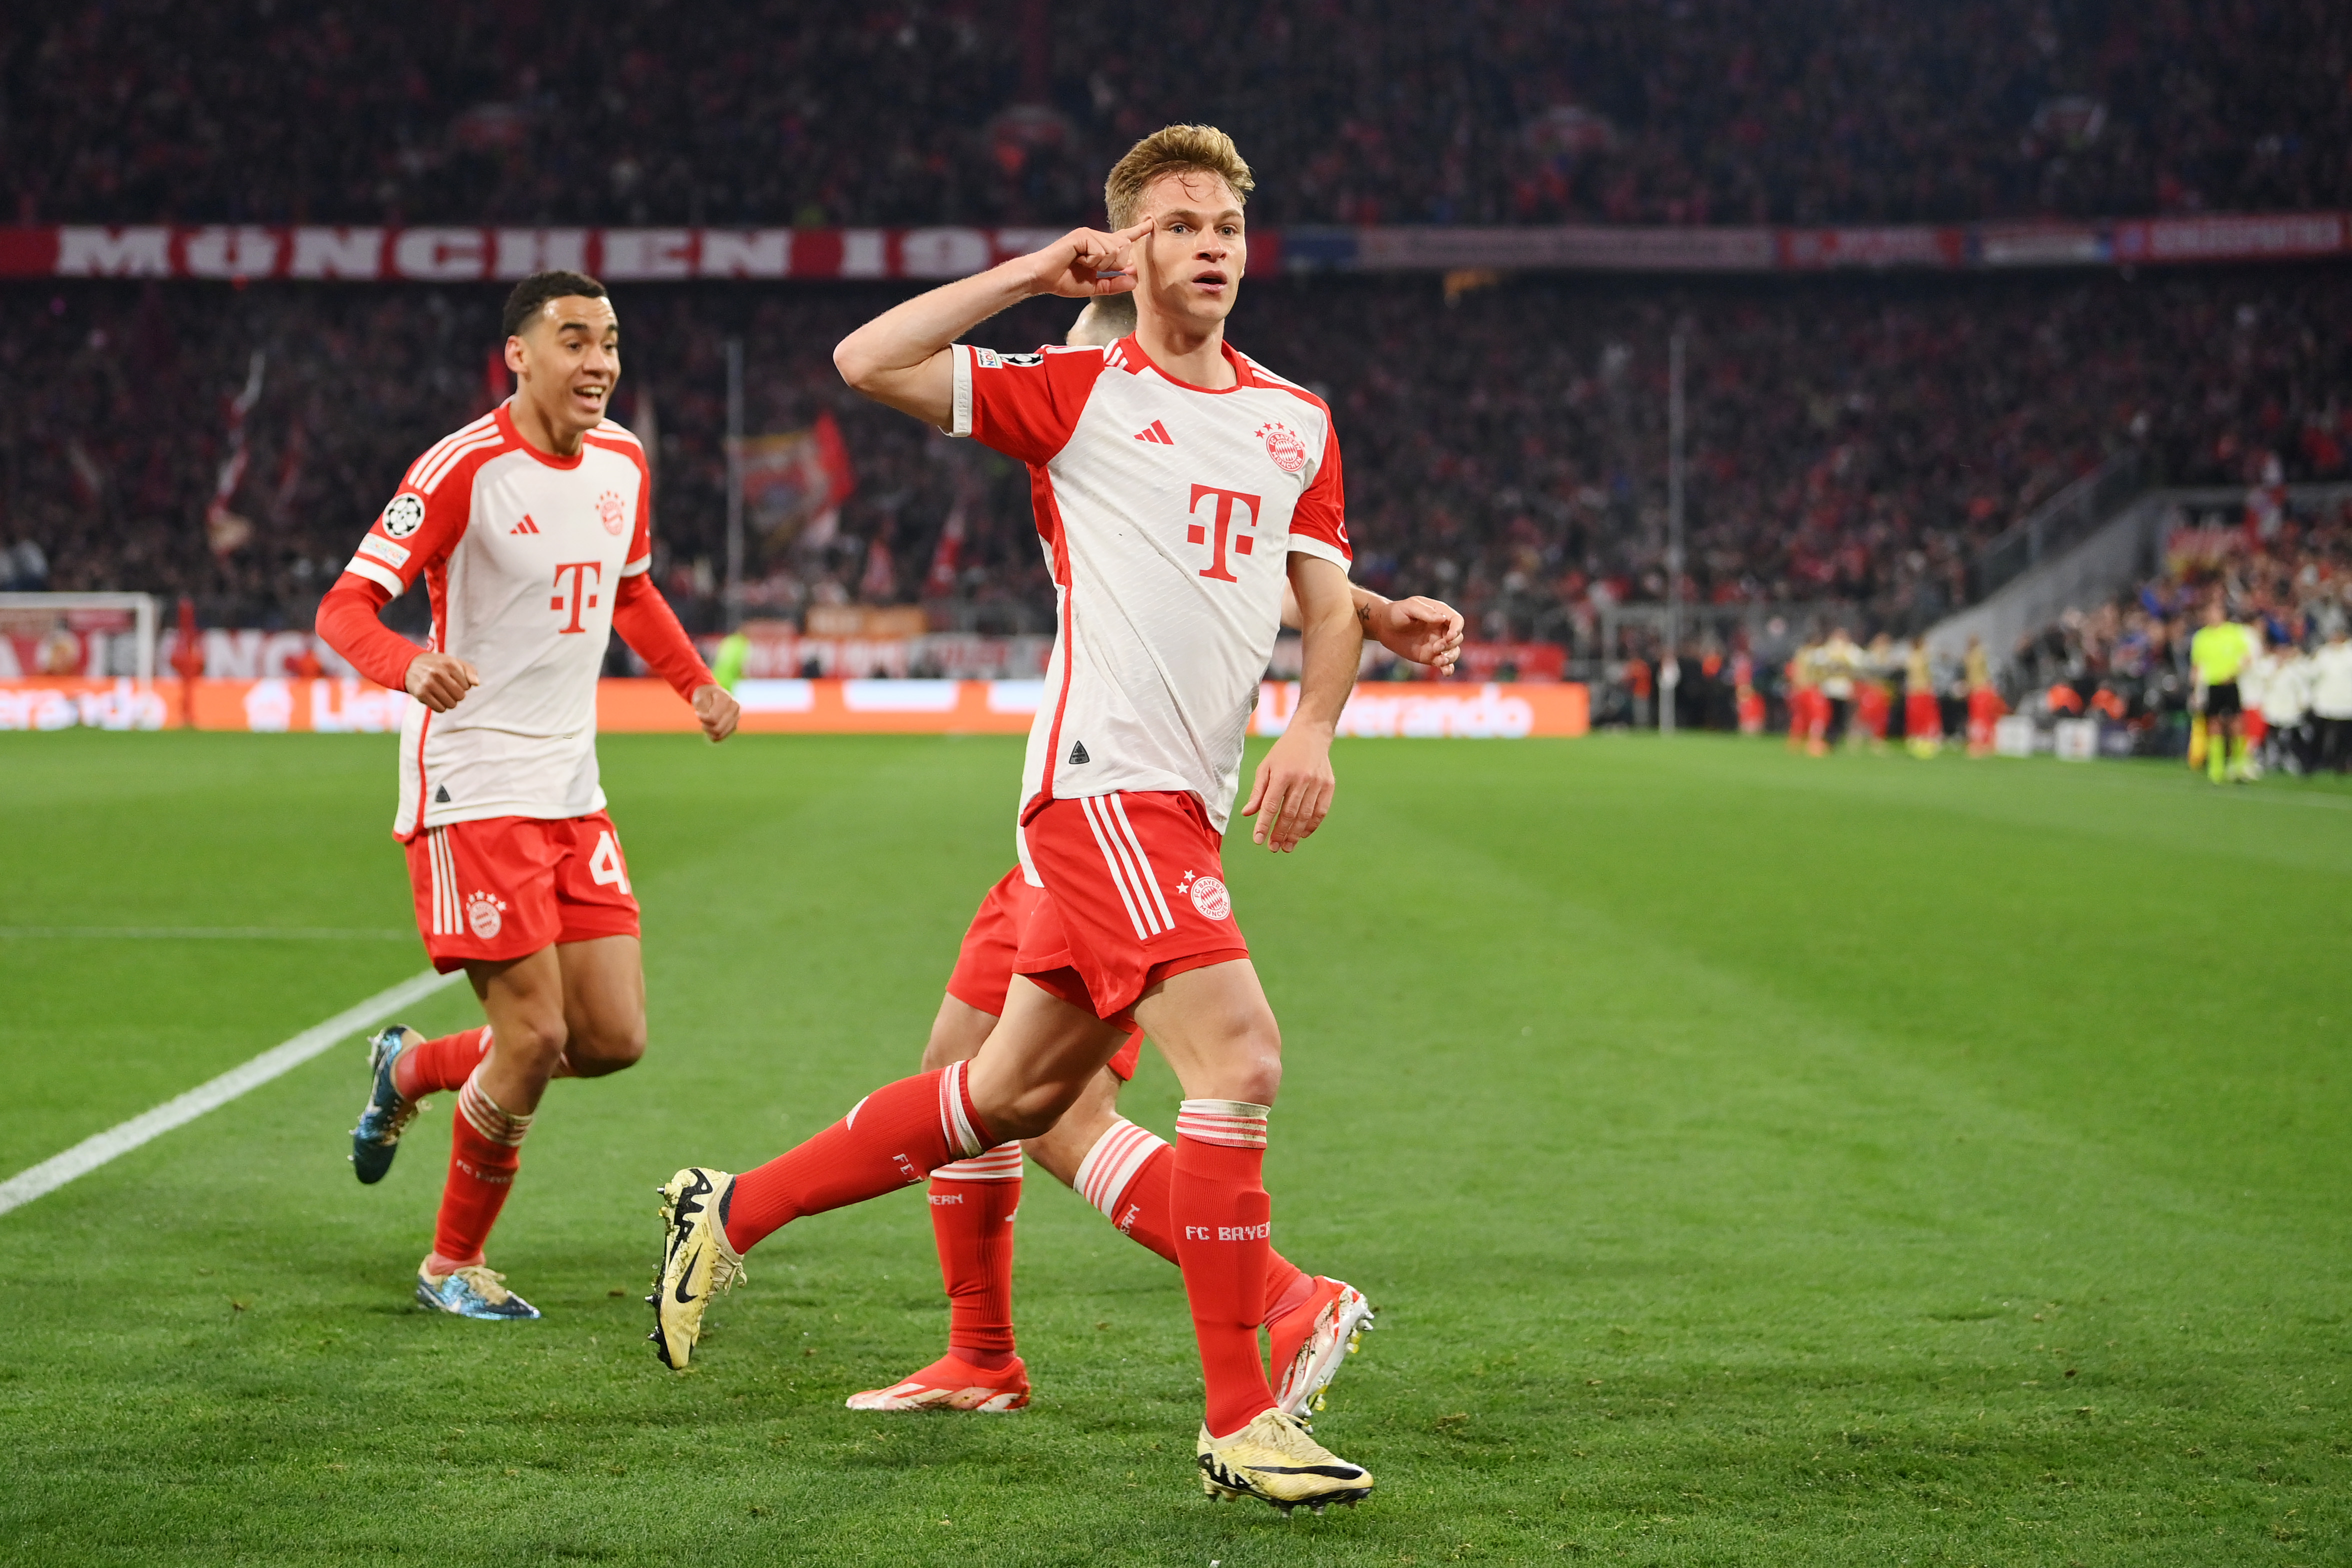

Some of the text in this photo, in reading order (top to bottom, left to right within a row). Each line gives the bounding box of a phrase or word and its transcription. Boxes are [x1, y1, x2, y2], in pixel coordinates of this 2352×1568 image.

[1269, 434, 1302, 450] FC BAYERN
[588, 830, 629, 895] 4
[1194, 880, 1224, 898] FC BAYERN
[892, 1153, 914, 1175] FC
[1186, 1226, 1210, 1240] FC
